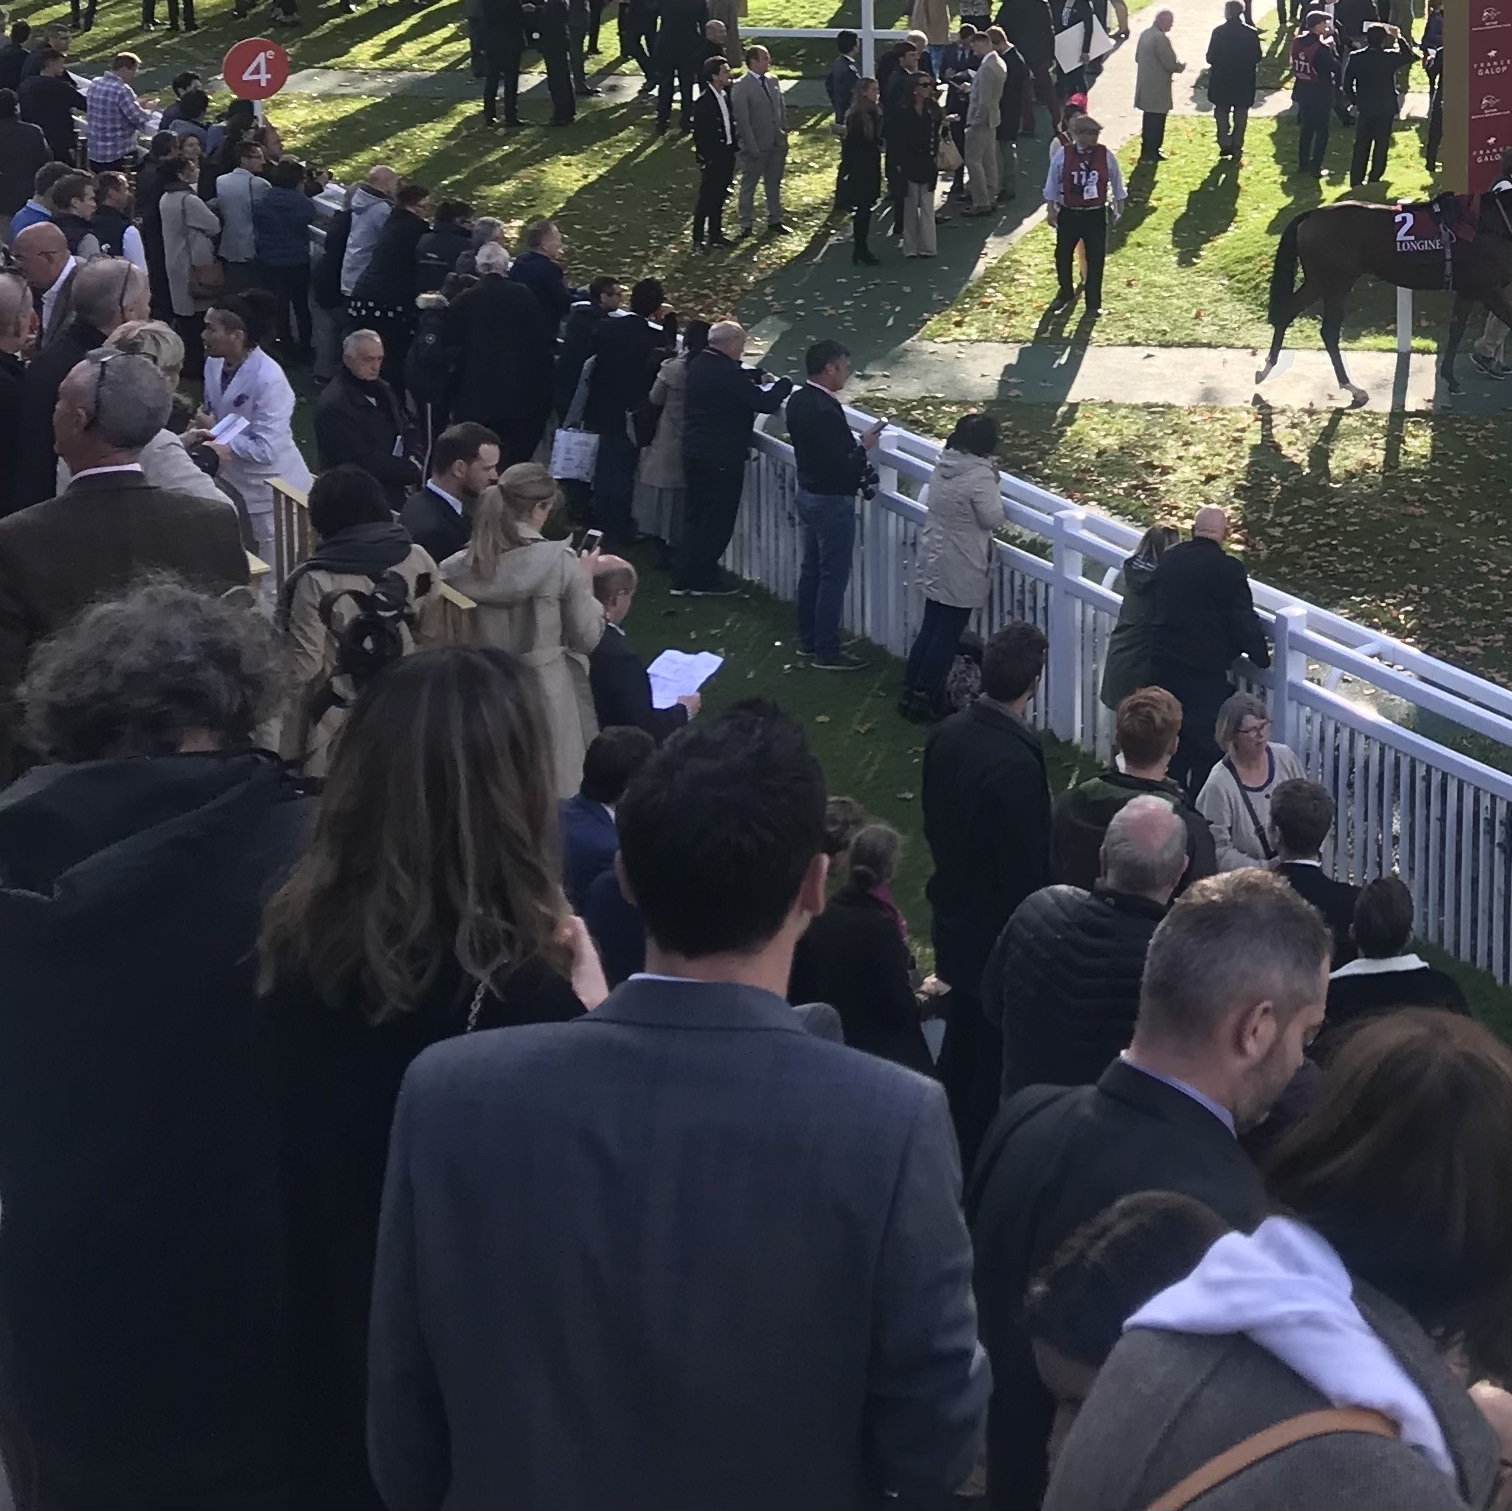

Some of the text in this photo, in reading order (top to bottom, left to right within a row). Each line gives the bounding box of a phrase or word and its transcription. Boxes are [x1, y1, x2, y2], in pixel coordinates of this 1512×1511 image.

[1473, 59, 1511, 68] FRANCE
[1477, 66, 1508, 76] GALOP
[1473, 147, 1504, 156] FRANC
[1476, 153, 1501, 163] GALO
[1394, 212, 1415, 241] 2
[1396, 239, 1444, 252] LONGINE
